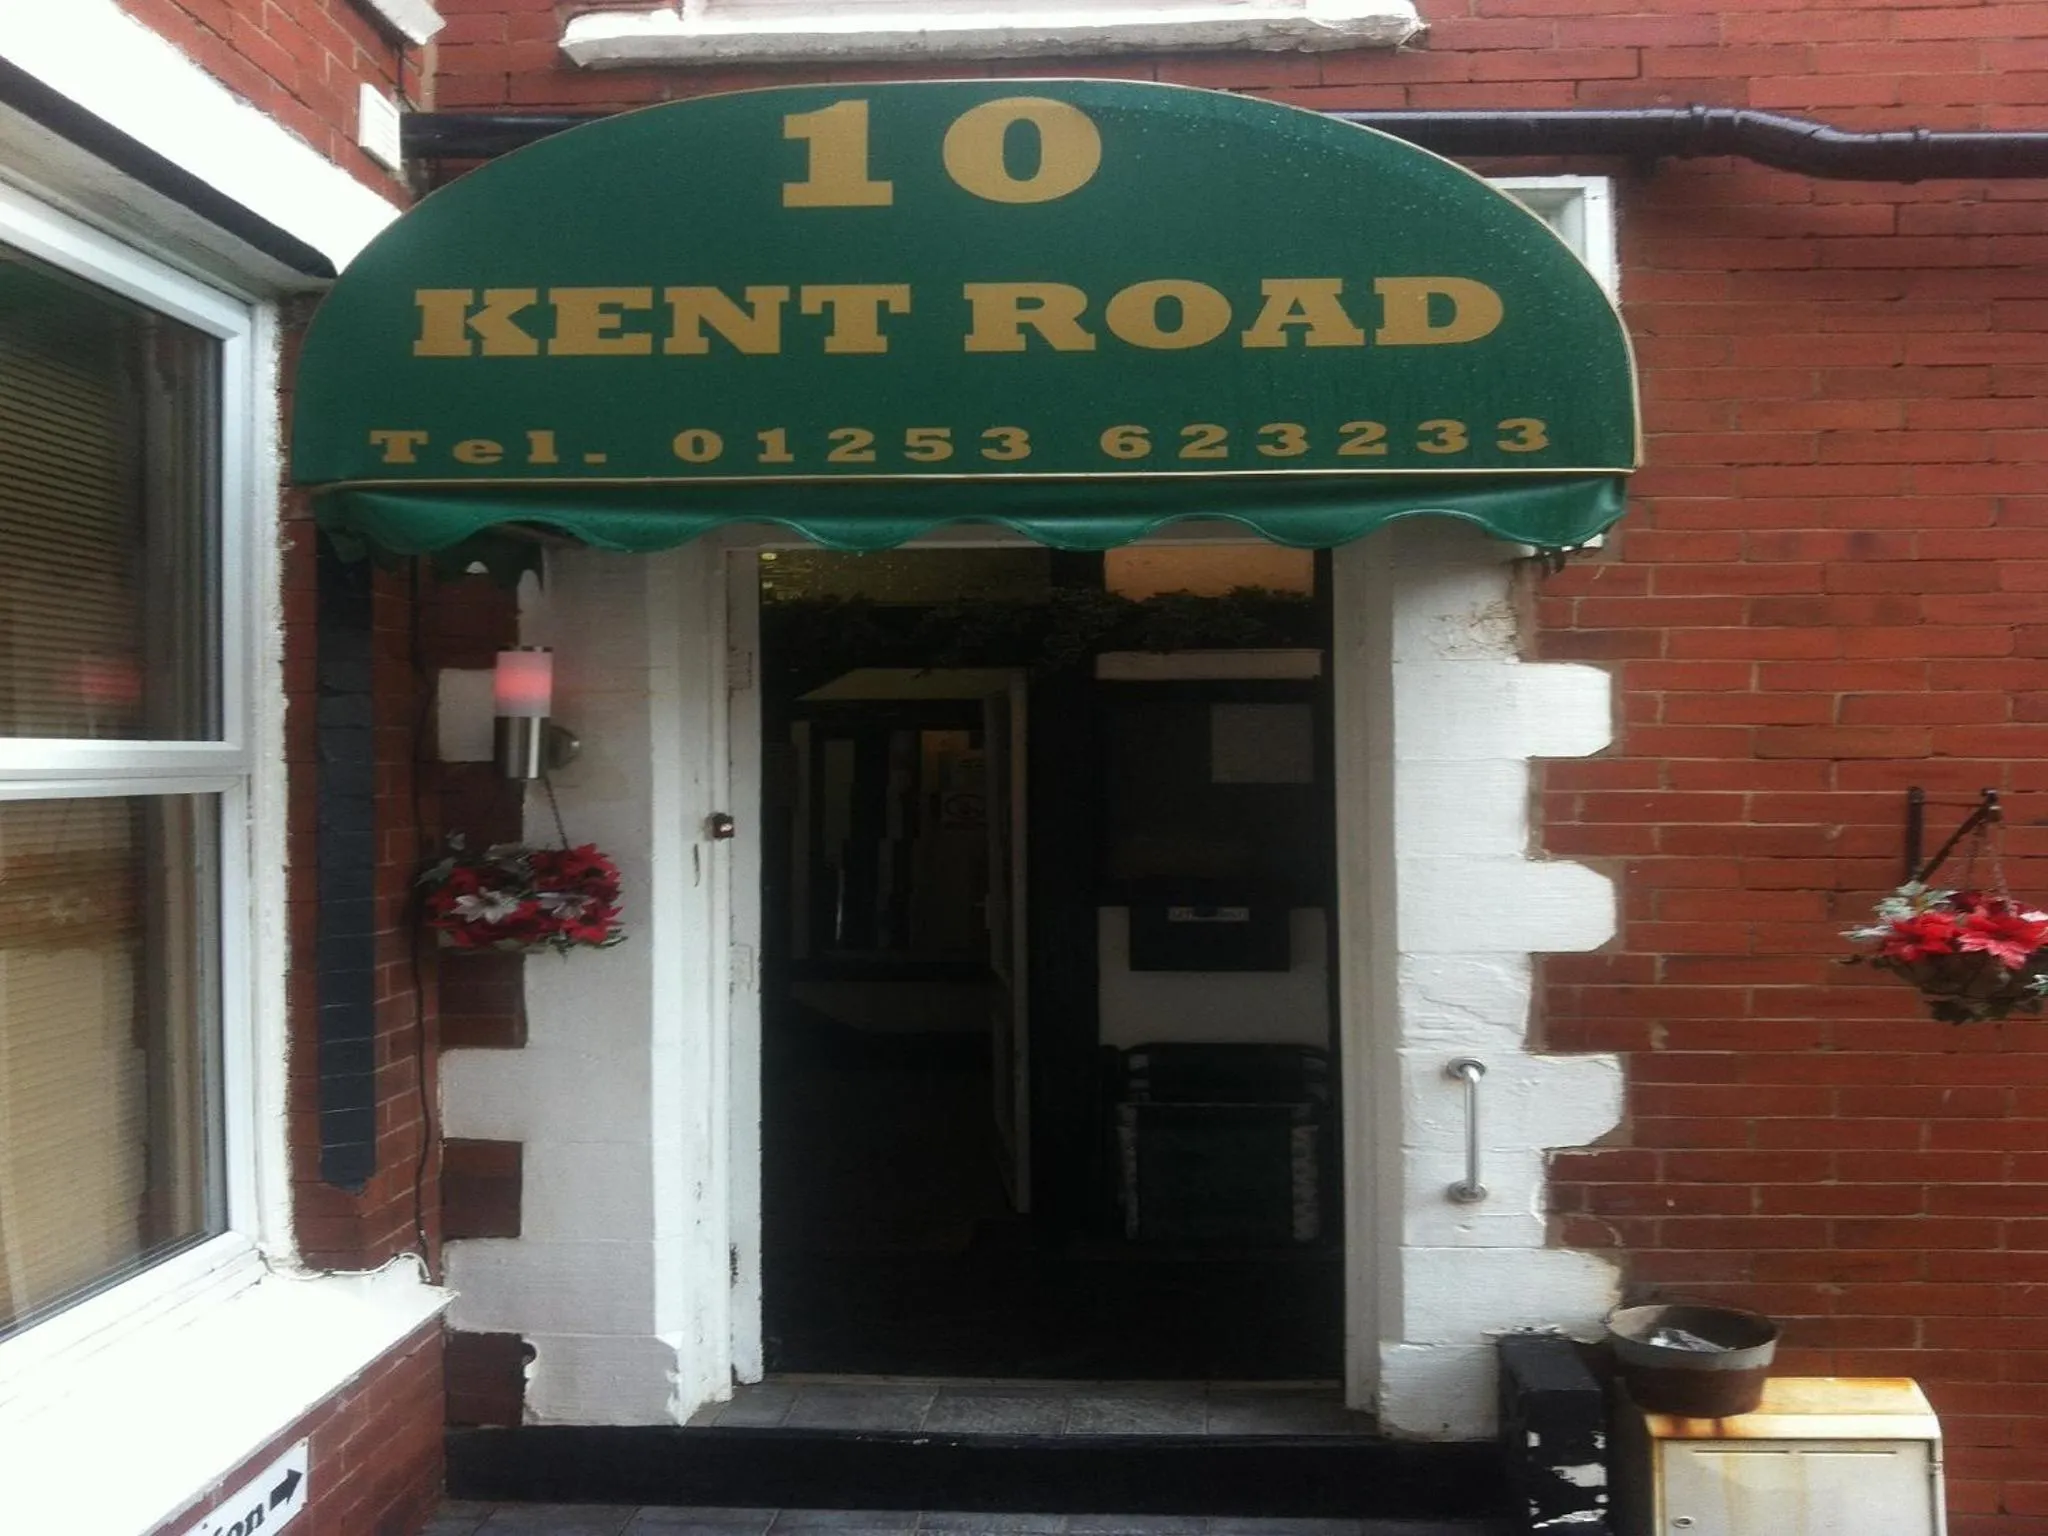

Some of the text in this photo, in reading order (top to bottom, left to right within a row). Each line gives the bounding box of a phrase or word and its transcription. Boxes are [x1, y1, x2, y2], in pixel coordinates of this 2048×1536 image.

[782, 98, 1103, 209] 10
[413, 276, 1504, 358] KENT ROAD
[369, 417, 1550, 465] Tel. 01253 623233
